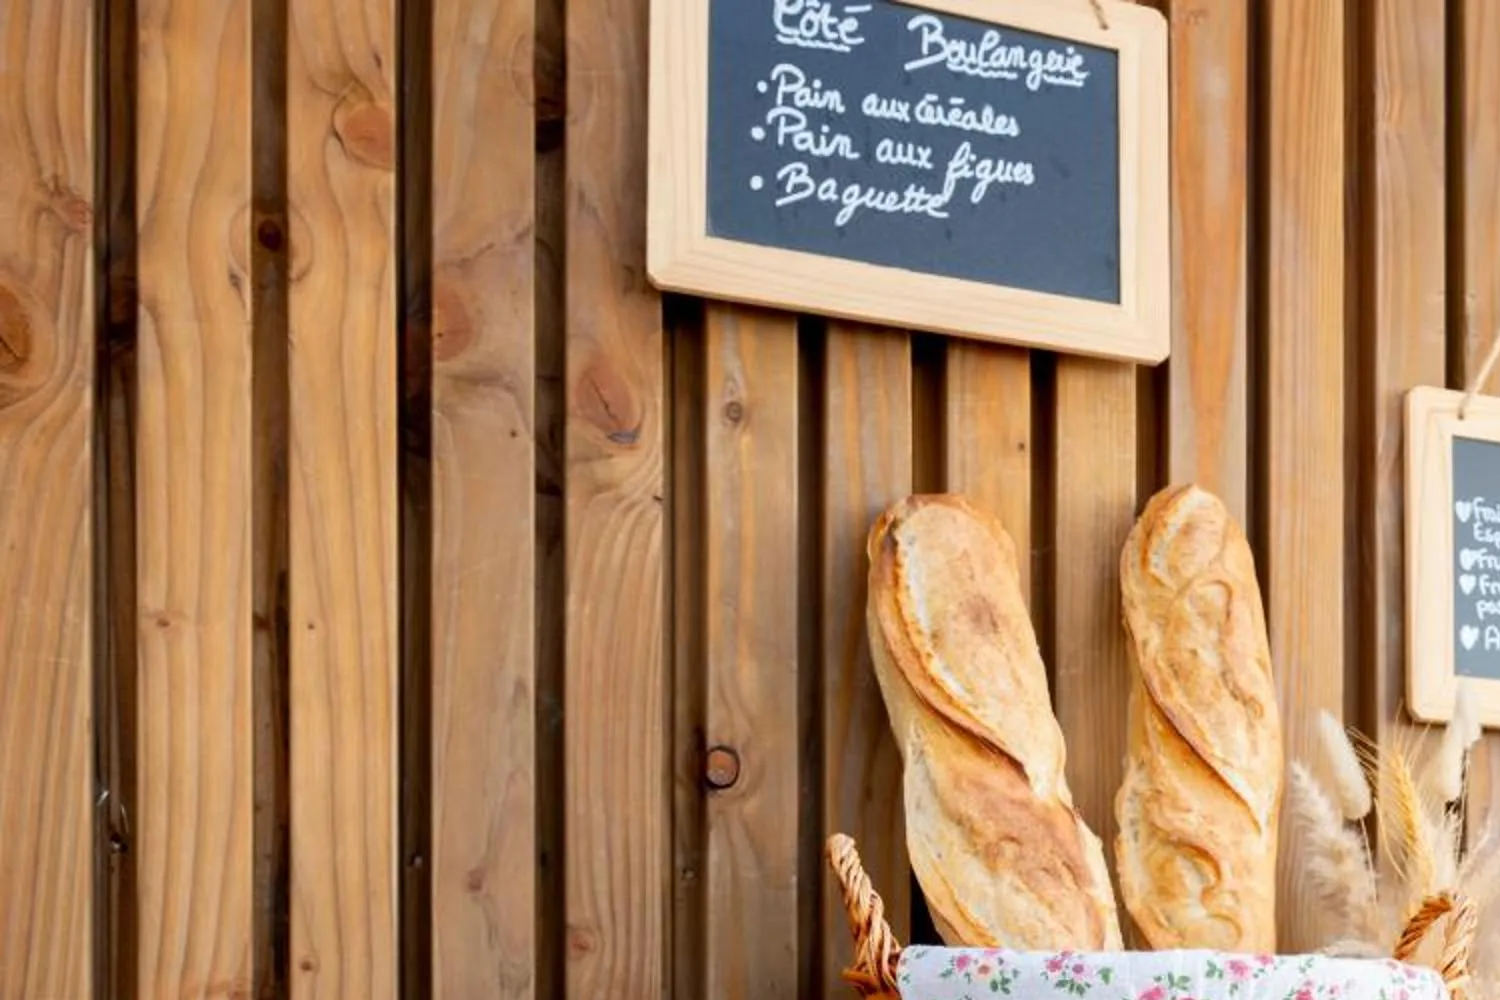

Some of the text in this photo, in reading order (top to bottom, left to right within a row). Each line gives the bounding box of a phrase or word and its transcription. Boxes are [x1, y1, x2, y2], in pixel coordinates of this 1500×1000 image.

[905, 14, 1088, 90] Boulangerie
[770, 63, 1020, 137] Pain aux céréales
[766, 107, 1035, 204] Pain aux figues
[774, 162, 950, 226] Baguette
